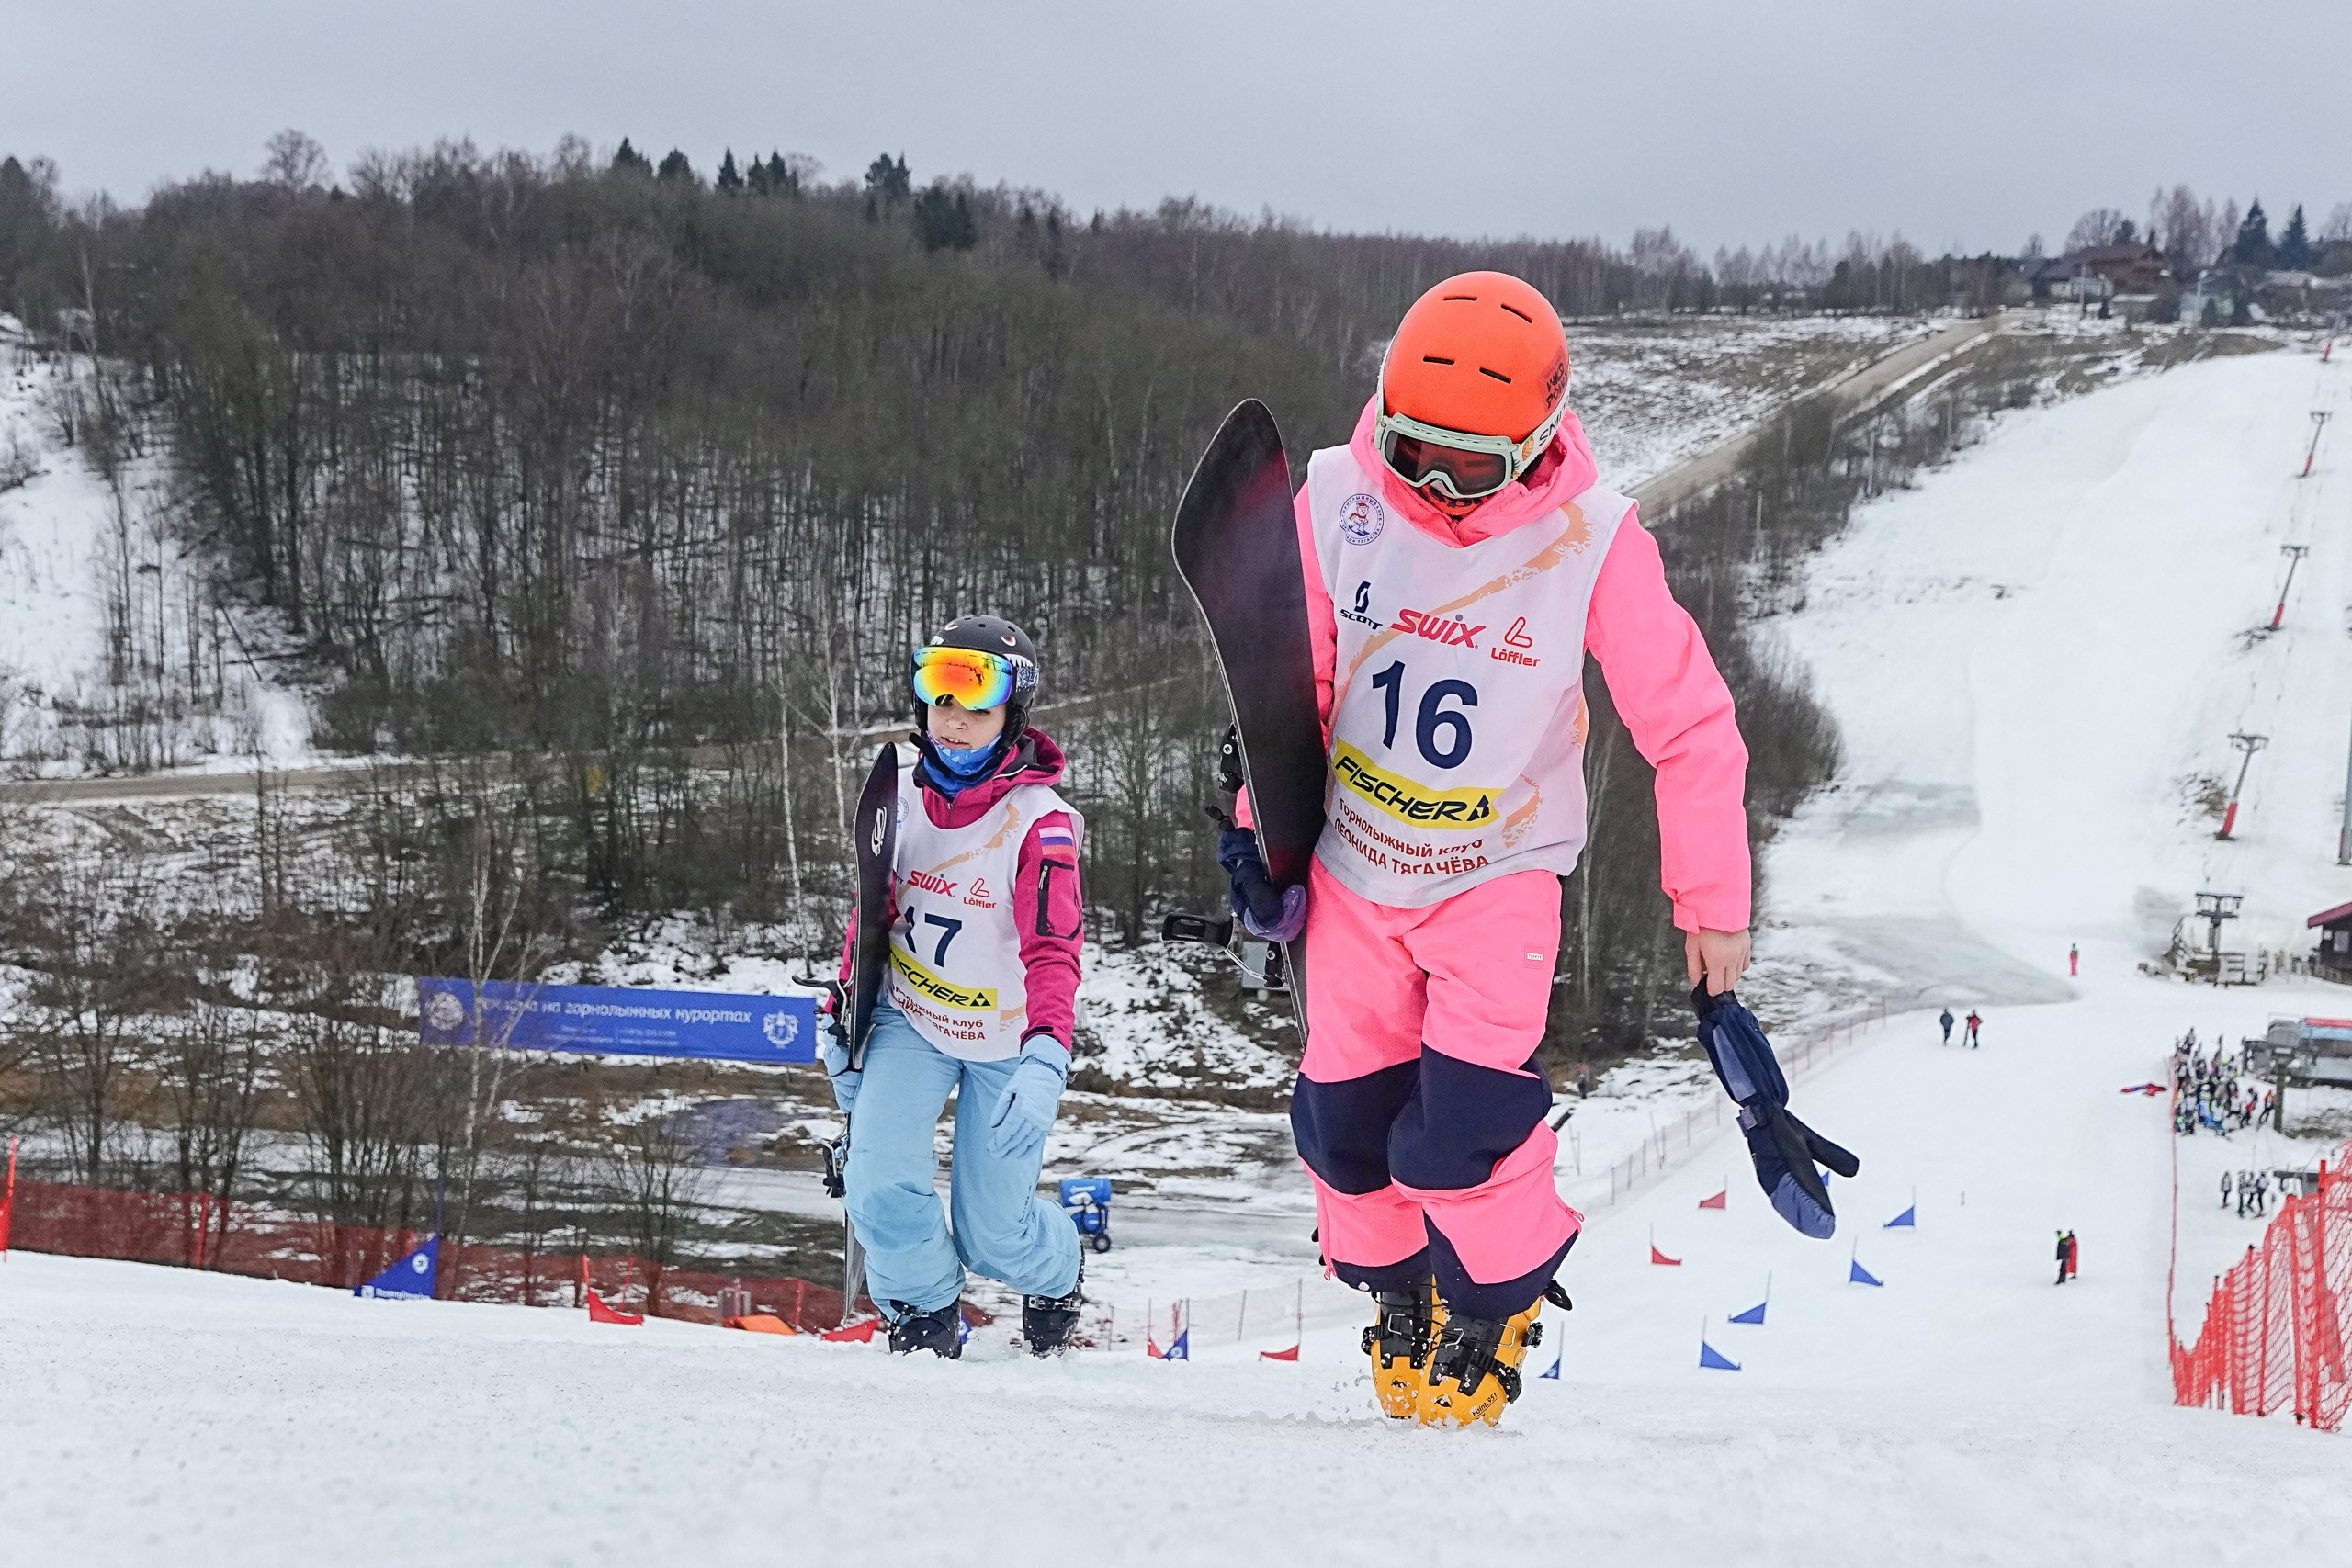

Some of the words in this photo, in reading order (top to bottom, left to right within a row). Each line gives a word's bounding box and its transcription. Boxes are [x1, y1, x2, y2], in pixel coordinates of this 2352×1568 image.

[1339, 609, 1383, 630] SCOTT
[1490, 647, 1541, 667] Löffler
[1372, 660, 1478, 770] 16
[1335, 755, 1467, 821] FISCHER
[1334, 817, 1387, 870] ЛЕОНИДА
[1391, 855, 1490, 874] ТЯГАЧЁВА
[904, 905, 963, 968] 17
[674, 1008, 752, 1024] курортах
[952, 1019, 984, 1030] клуб
